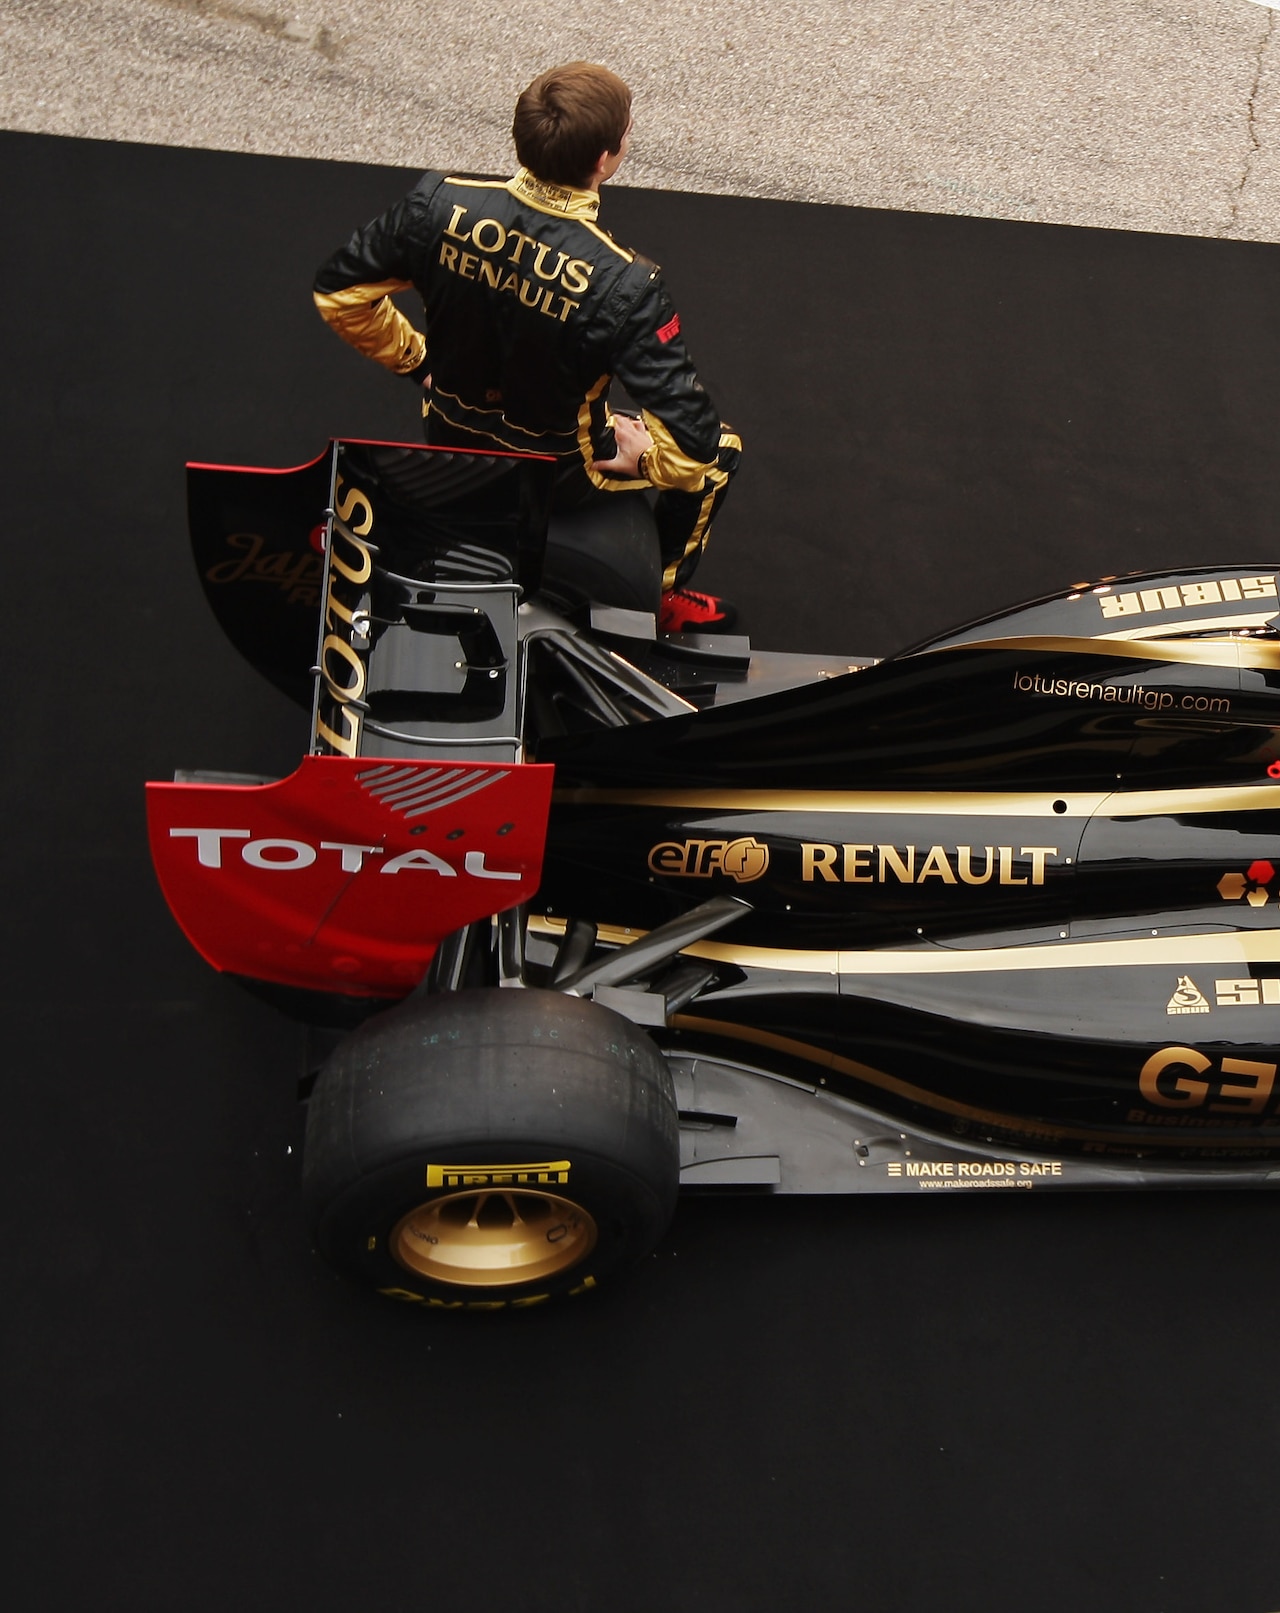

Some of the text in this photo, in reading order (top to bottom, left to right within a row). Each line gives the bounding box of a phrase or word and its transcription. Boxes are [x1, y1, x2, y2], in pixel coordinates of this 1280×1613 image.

[443, 204, 593, 294] LOTUS
[438, 242, 580, 322] RENAULT
[315, 473, 373, 758] LOTUS
[1099, 576, 1276, 619] SIBUR
[1013, 671, 1230, 713] lotusrenaultgp.com
[169, 828, 521, 880] TOTAL
[648, 839, 727, 878] elf
[801, 844, 1058, 887] RENAULT
[427, 1160, 572, 1188] PIRELLI
[906, 1162, 1062, 1177] MAKE ROADS SAFE
[919, 1179, 1033, 1190] www.makeroadssafe.org
